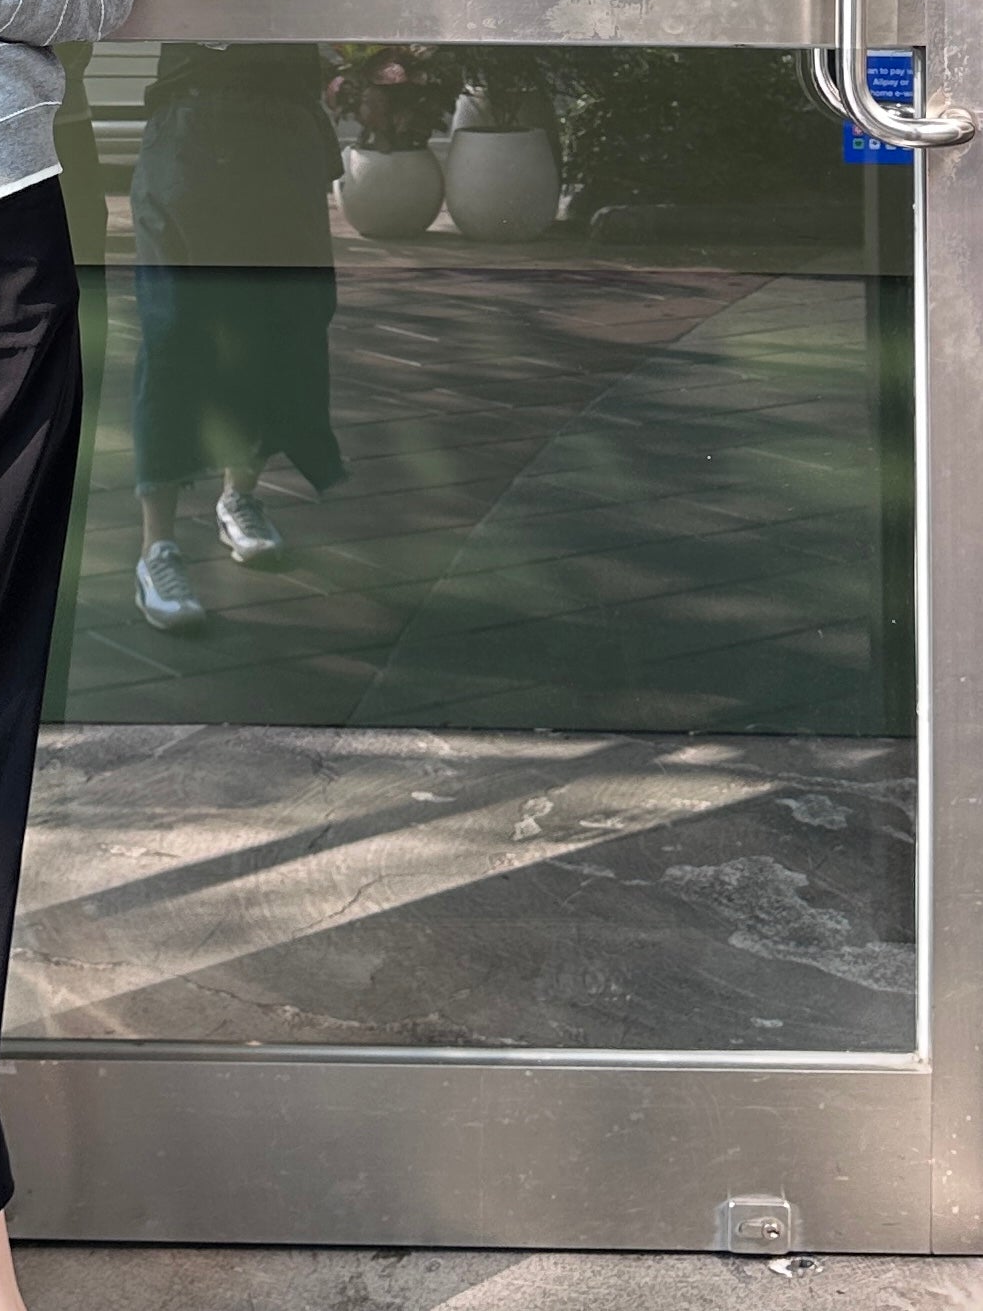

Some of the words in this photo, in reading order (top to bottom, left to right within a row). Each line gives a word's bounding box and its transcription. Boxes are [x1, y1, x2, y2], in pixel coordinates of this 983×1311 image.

[879, 67, 889, 75] to
[890, 68, 905, 77] pay
[873, 78, 899, 88] Alipay
[900, 78, 910, 86] or
